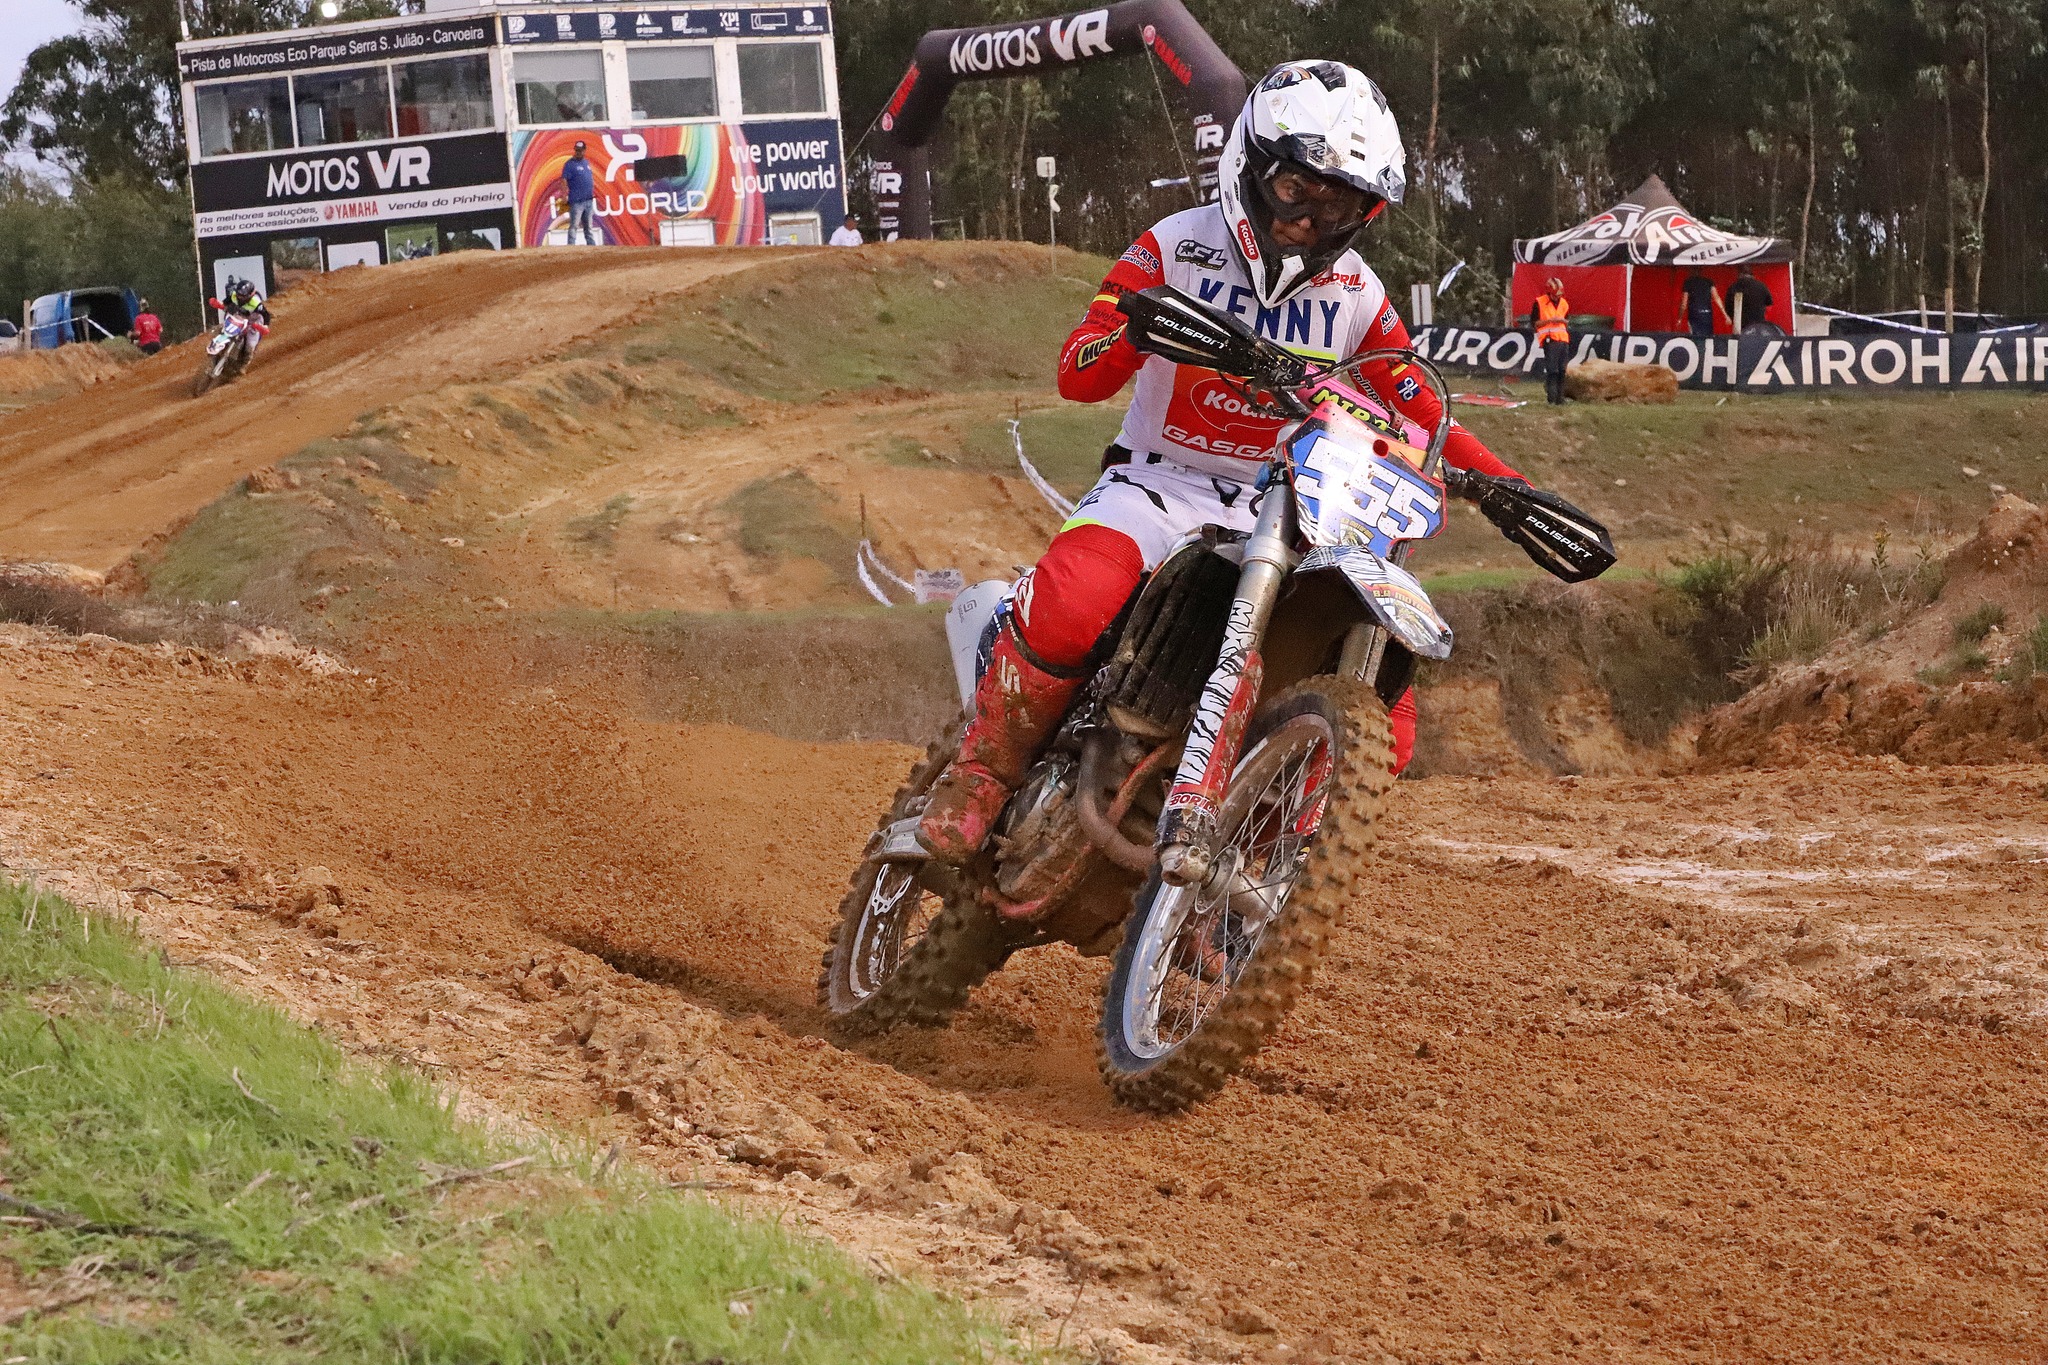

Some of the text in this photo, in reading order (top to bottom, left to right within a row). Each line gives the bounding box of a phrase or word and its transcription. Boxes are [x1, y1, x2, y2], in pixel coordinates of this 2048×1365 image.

[191, 57, 217, 73] Pista
[218, 56, 231, 71] de
[233, 52, 285, 68] Motocross
[287, 47, 308, 62] Eco
[310, 44, 347, 60] Parque
[349, 39, 377, 55] Serra
[380, 36, 391, 51] S.
[394, 32, 424, 49] Julião
[433, 26, 484, 44] Carvoeira
[950, 9, 1114, 74] MOTOS VR
[729, 140, 829, 168] we power
[267, 146, 431, 198] MOTOS VR
[731, 164, 836, 199] your world
[200, 217, 213, 225] As
[216, 212, 264, 223] melhores
[335, 200, 379, 219] YAMAHA
[388, 192, 505, 211] Venda do Pinheiro
[200, 216, 319, 234] no seu concessionário
[1239, 223, 1256, 257] Koala
[1198, 277, 1341, 348] KENNY
[1567, 332, 1739, 385] AIROH
[1748, 337, 1951, 385] AIROH
[1163, 424, 1277, 459] GASGA
[1526, 515, 1593, 558] POLISPORT
